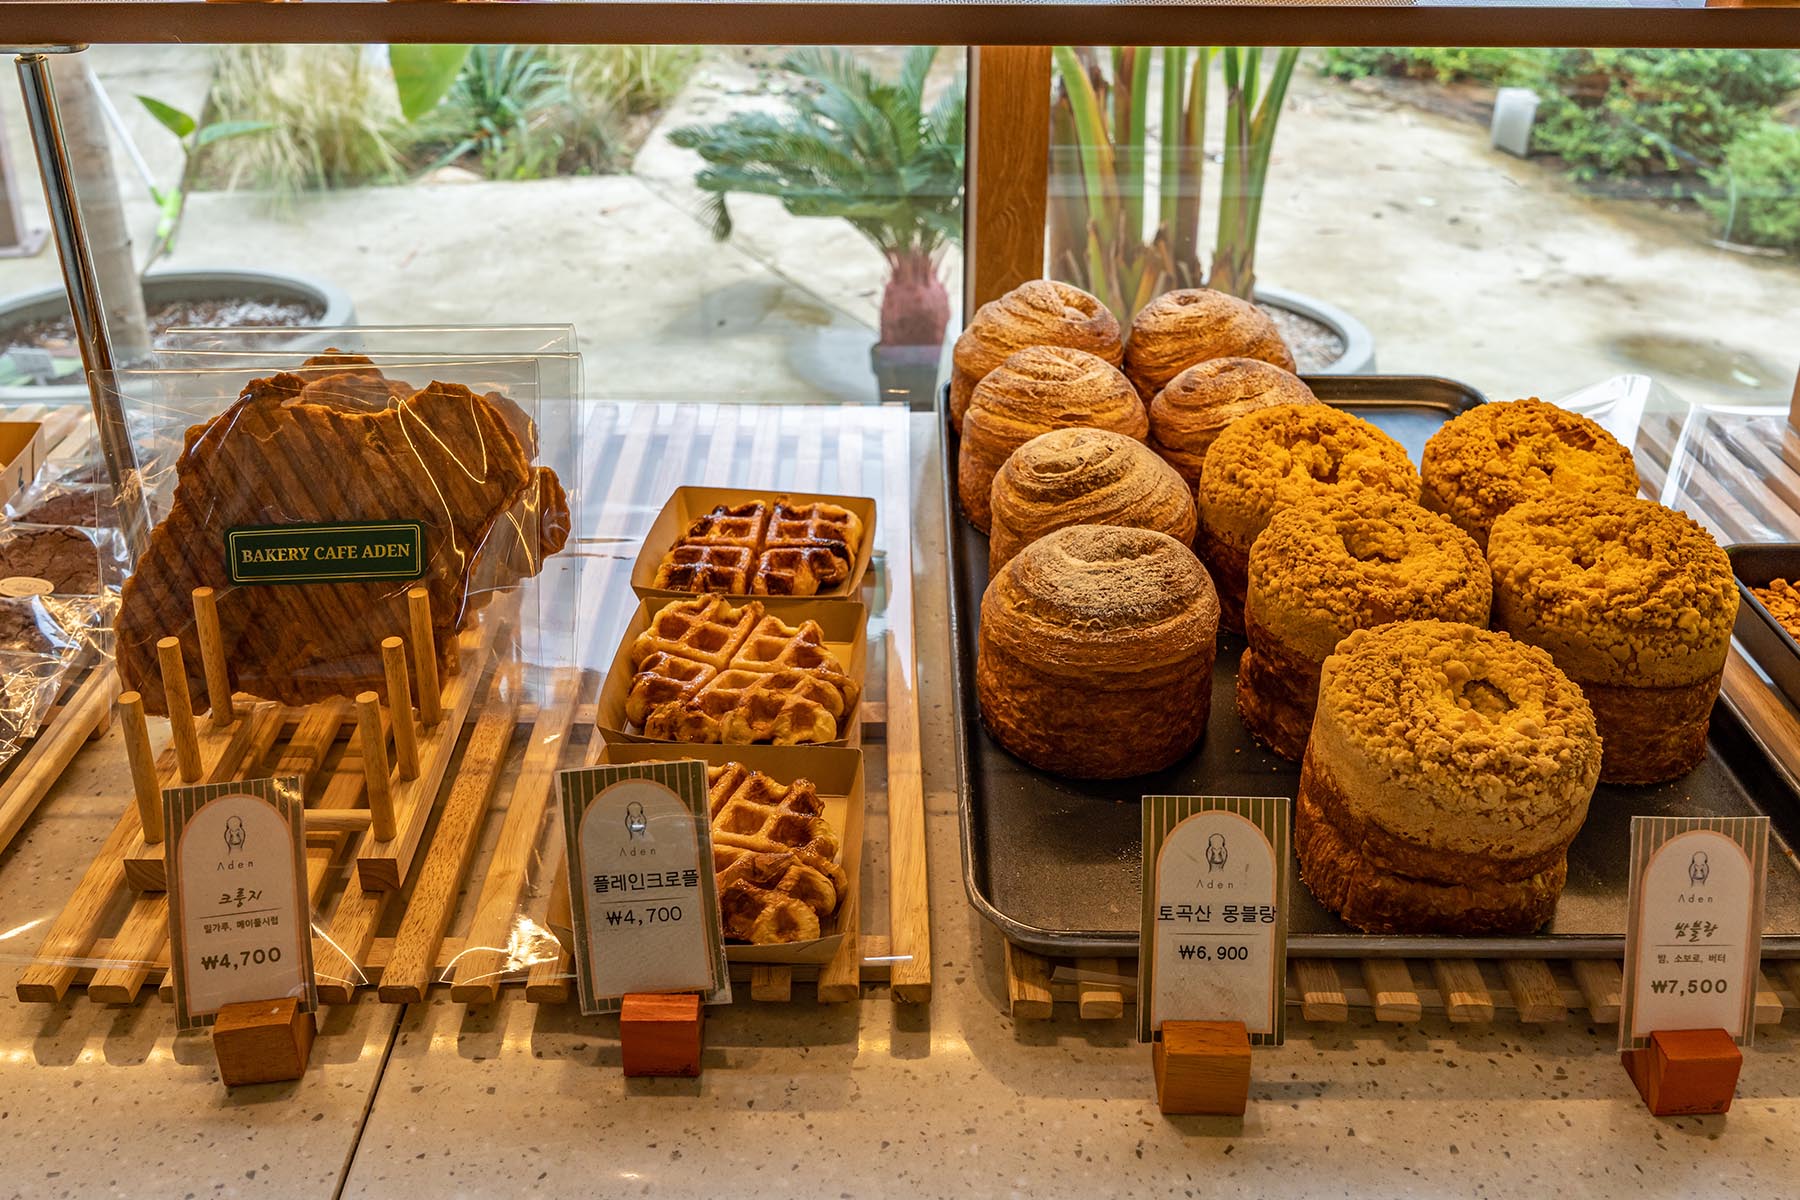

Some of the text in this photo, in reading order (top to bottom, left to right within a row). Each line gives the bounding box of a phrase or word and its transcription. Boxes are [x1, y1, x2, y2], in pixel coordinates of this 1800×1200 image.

[242, 543, 410, 563] BAKERY CAFE ADEN
[593, 869, 700, 893] 플레인크로플
[606, 905, 682, 926] ₩4,700
[1157, 905, 1277, 924] 토곡산 몽블랑
[201, 947, 281, 971] ₩4,700
[1708, 953, 1726, 964] 버터
[1651, 979, 1728, 997] ₩7,500
